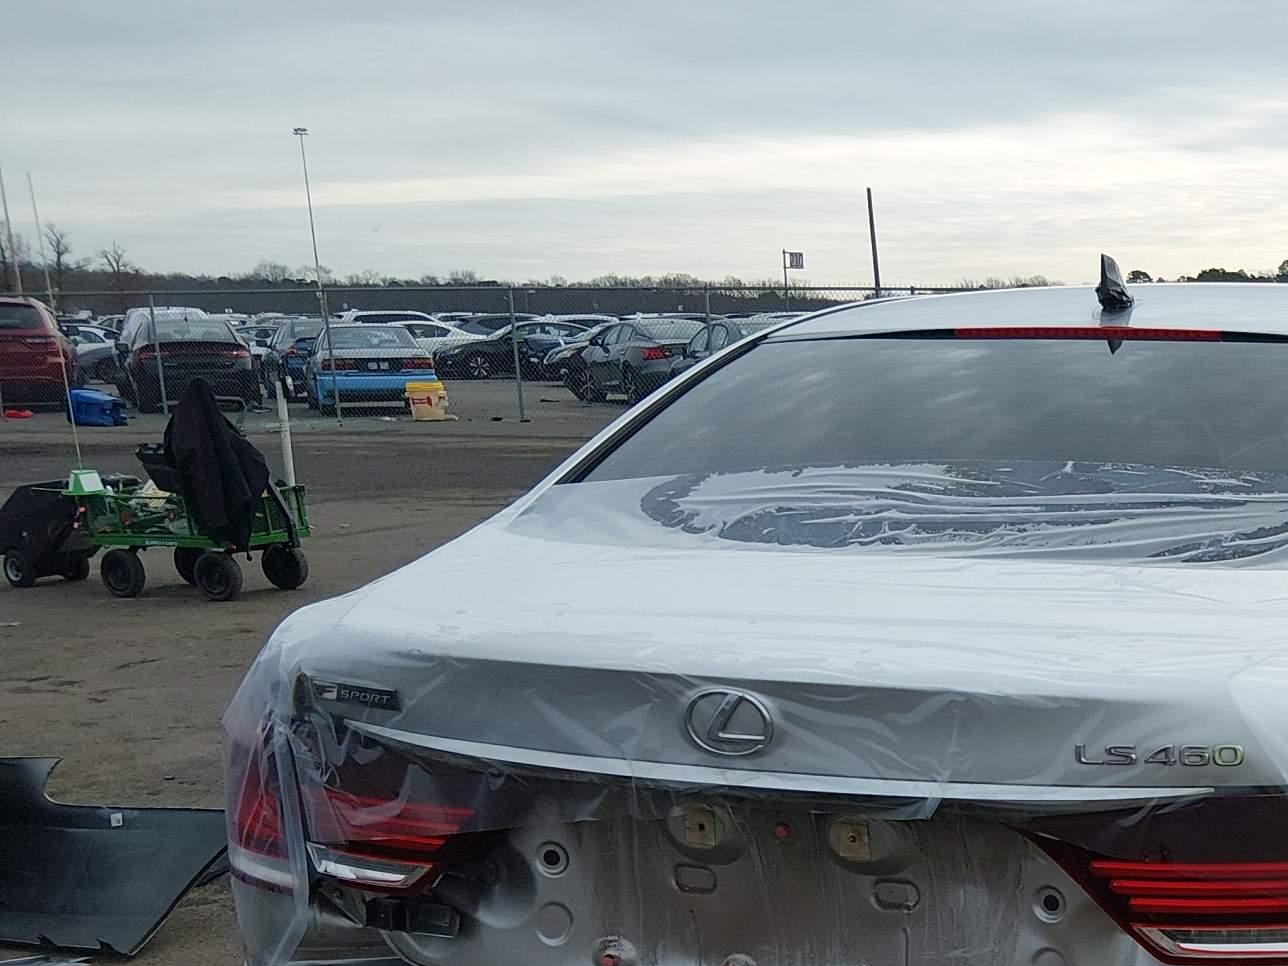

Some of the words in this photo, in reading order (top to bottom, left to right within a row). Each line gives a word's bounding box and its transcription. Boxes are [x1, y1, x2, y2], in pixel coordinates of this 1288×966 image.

[341, 689, 391, 705] SPORT
[1074, 743, 1138, 766] LS
[1144, 743, 1245, 767] 460
